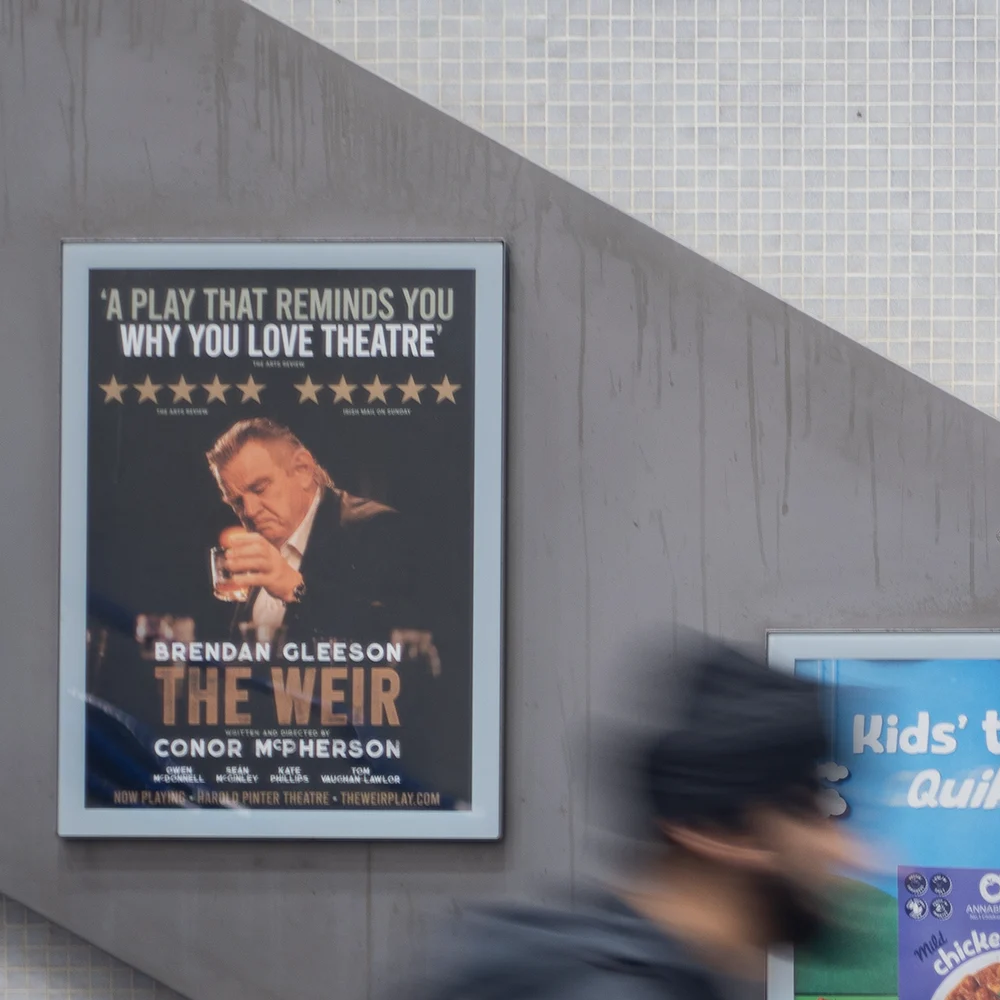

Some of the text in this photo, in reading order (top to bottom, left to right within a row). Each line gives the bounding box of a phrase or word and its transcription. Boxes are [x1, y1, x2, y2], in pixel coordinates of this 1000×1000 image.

[131, 288, 196, 321] PLAY
[203, 288, 268, 321] THAT
[276, 288, 394, 321] REMINDS
[402, 288, 454, 321] YOU
[120, 323, 181, 358] WHY
[189, 323, 240, 358] YOU
[248, 323, 314, 358] LOVE
[154, 641, 402, 662] BRENDAN GLEESON
[154, 666, 401, 727] THE WEIR
[224, 729, 330, 737] WRITTEN AND DIRECTED BY
[154, 738, 242, 758] CONOR
[166, 766, 193, 775] OWEN
[269, 774, 310, 784] PHILLIPS
[278, 766, 301, 775] KATE
[351, 766, 371, 775] TOM
[113, 790, 441, 807] NOW PLAYING HAROLD PINTER THEATRE THEWEIRPLAY.COM
